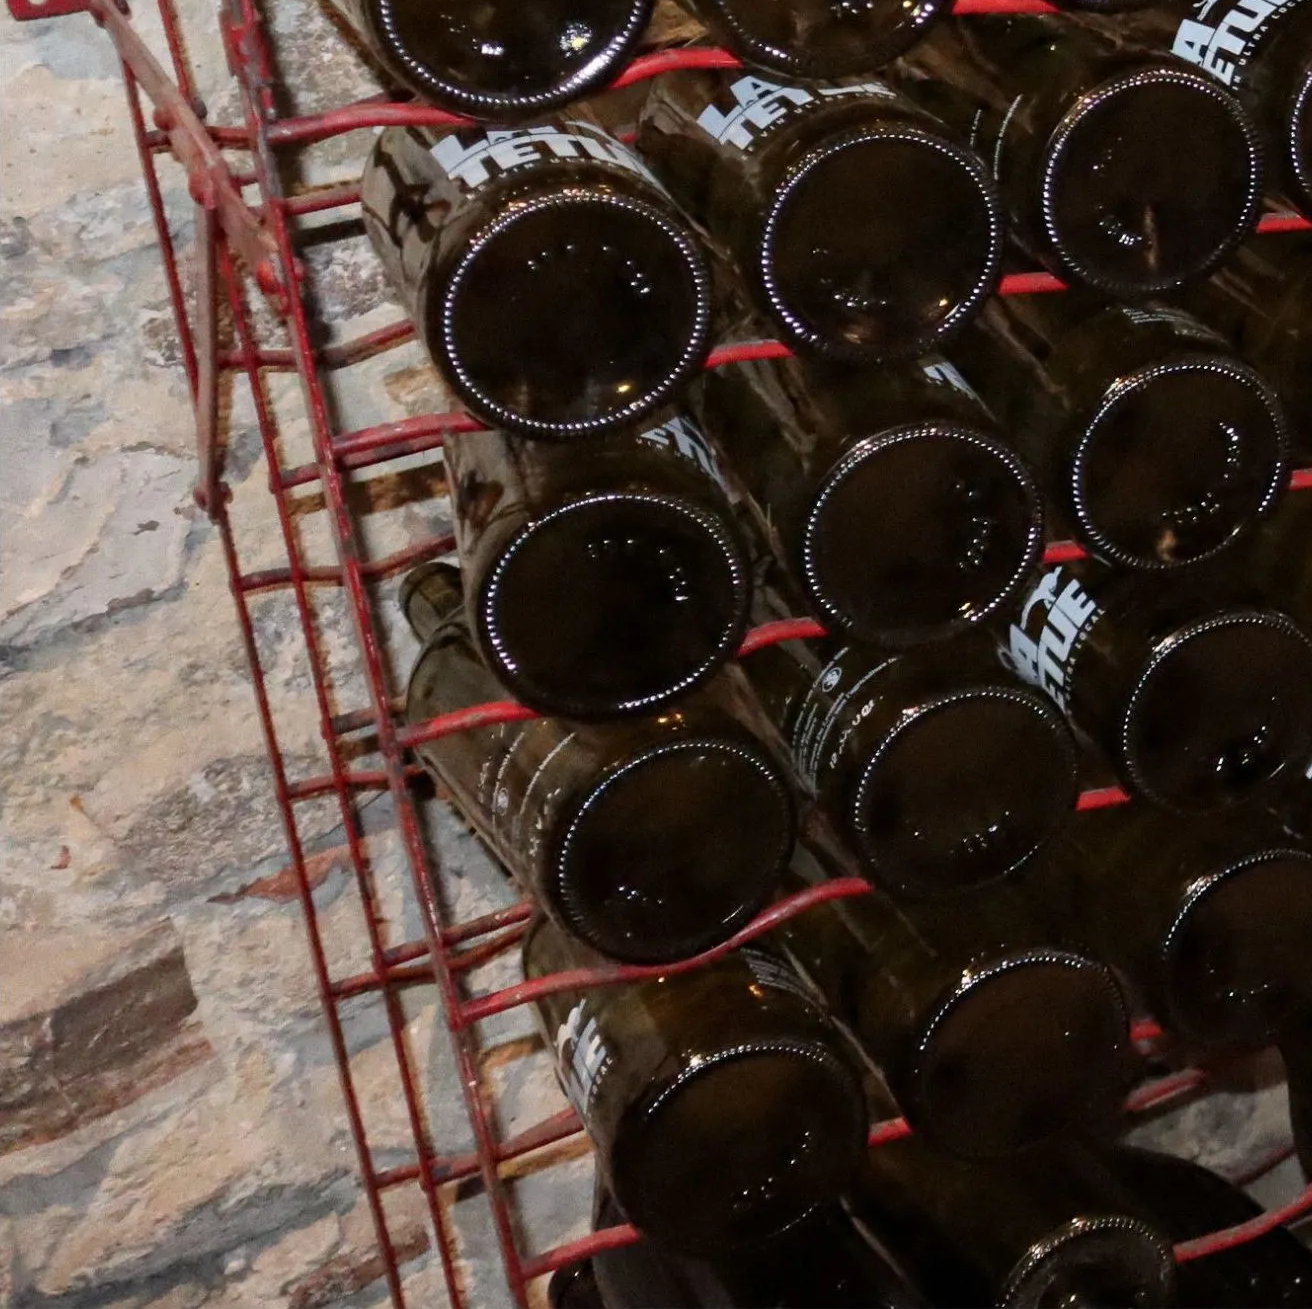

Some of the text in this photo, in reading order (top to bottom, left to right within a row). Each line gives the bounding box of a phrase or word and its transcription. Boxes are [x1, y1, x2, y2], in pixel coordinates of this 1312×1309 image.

[1170, 18, 1216, 68] A
[1238, 25, 1268, 66] ULTRA
[696, 76, 784, 139] LA
[449, 133, 671, 199] TETU
[1038, 579, 1096, 714] ETUE
